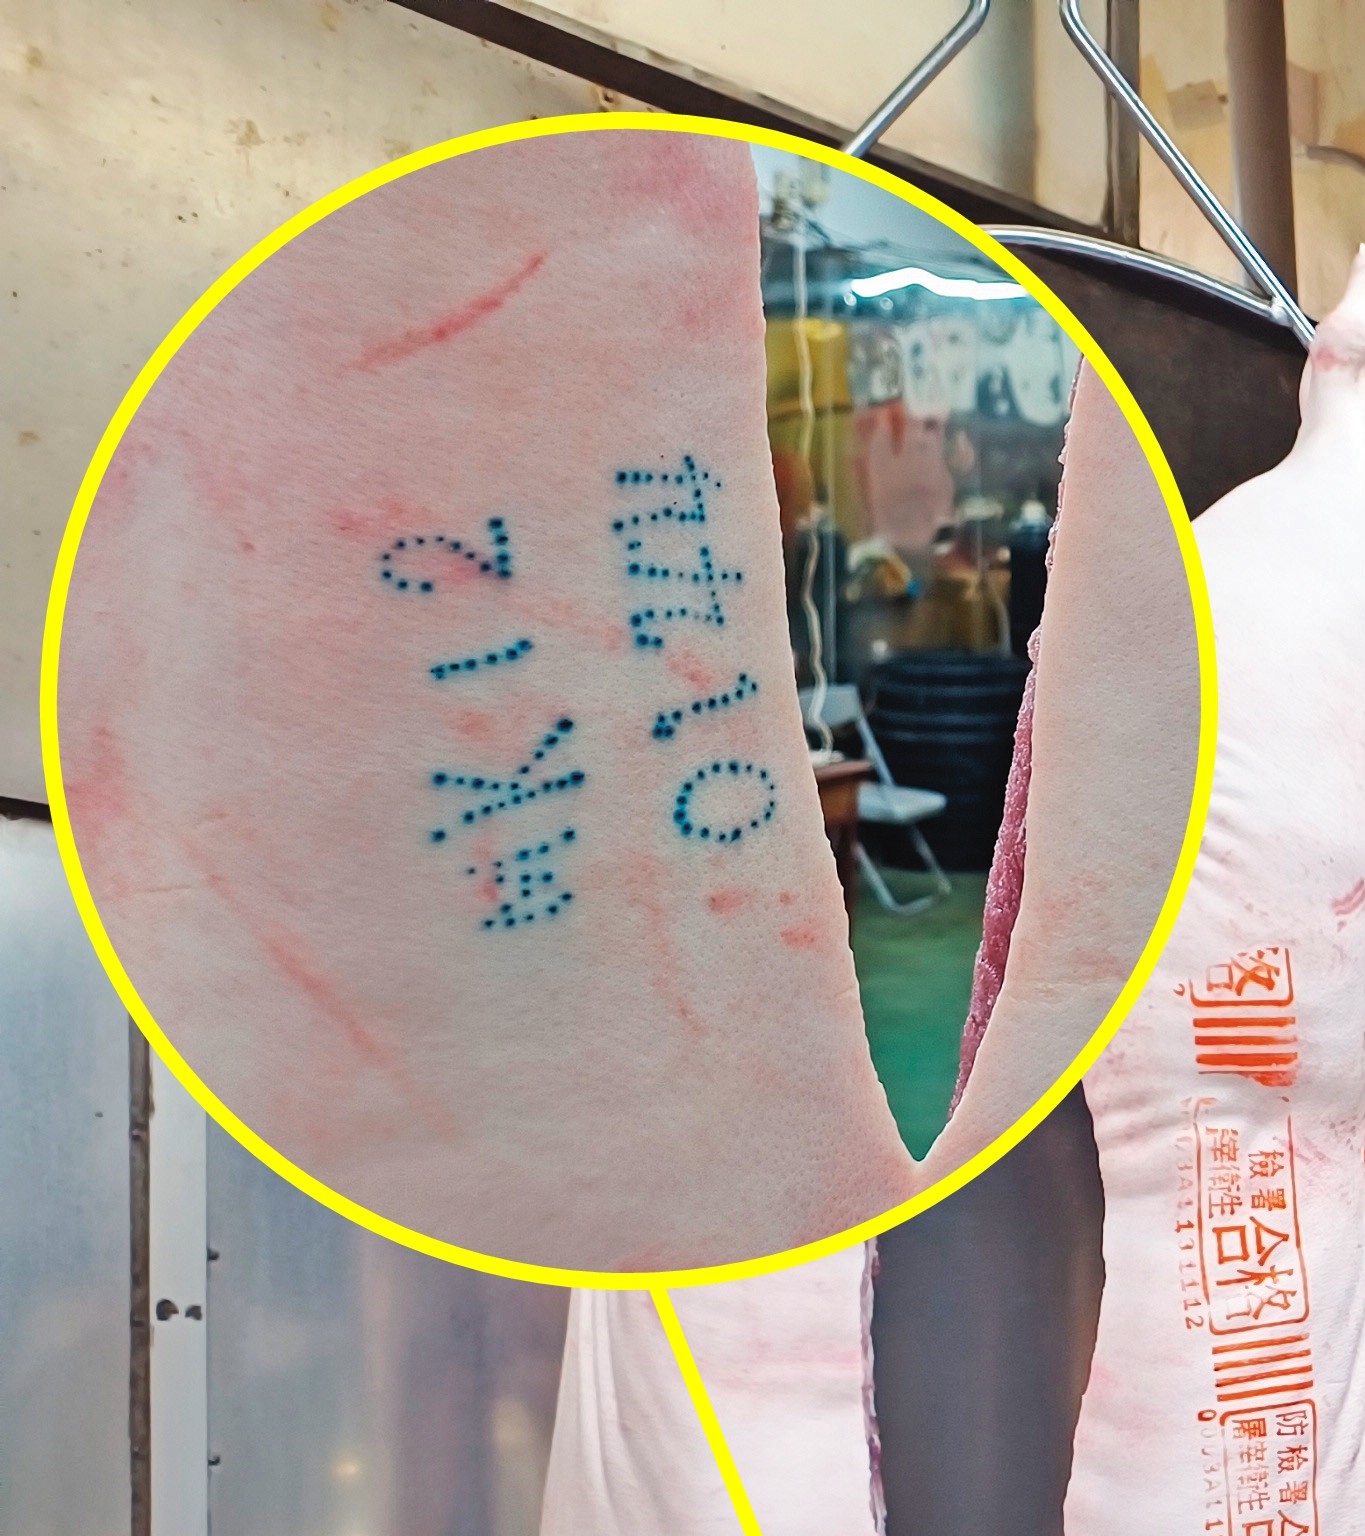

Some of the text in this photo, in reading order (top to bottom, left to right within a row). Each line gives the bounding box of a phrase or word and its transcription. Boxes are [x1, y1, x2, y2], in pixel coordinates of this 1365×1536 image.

[1212, 1217, 1296, 1320] 合格
[1276, 1409, 1309, 1505] 防檢署
